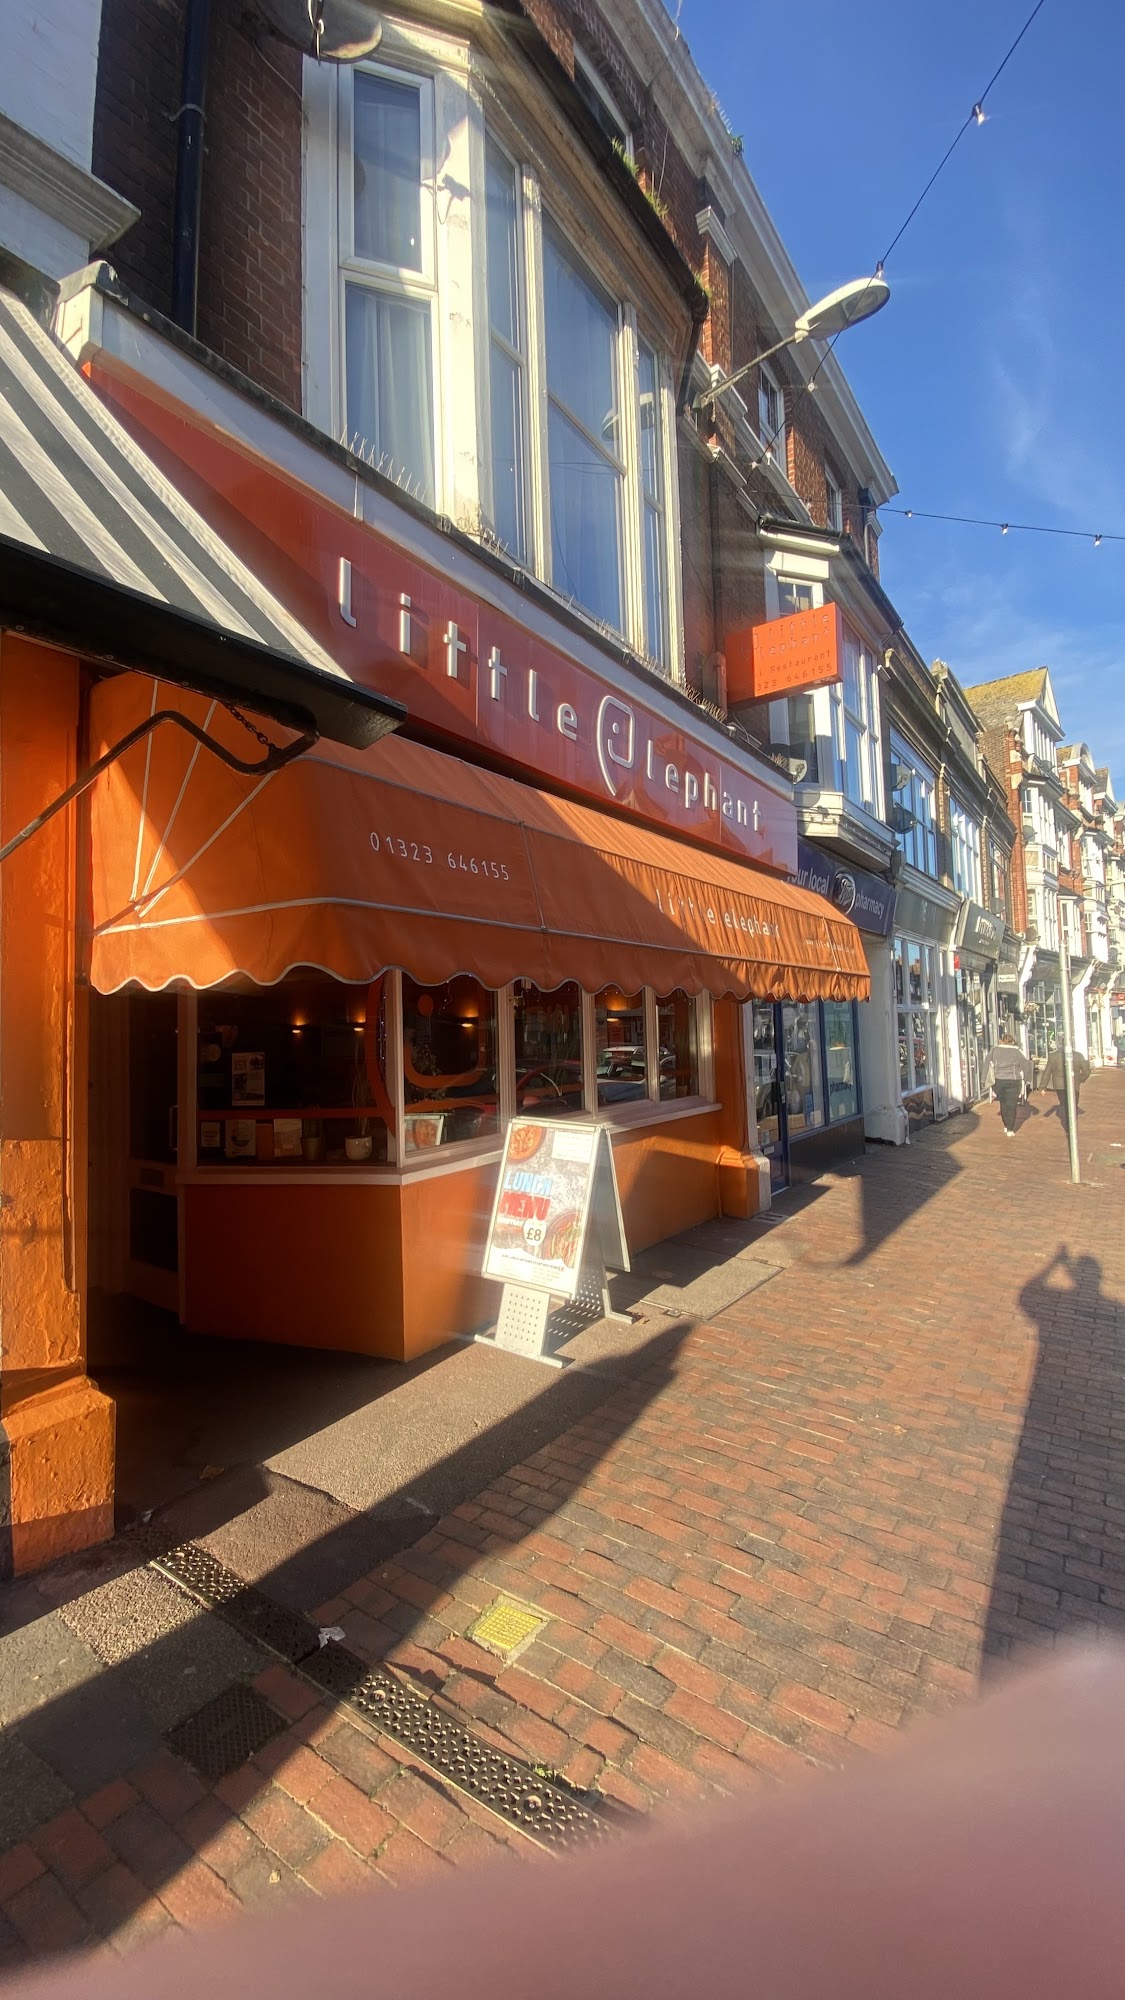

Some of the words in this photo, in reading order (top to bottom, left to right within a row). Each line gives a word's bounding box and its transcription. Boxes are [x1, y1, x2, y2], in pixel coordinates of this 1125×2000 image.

[769, 613, 830, 641] little
[339, 557, 578, 741] little
[769, 649, 831, 674] Restaurant
[786, 663, 832, 683] 646155
[370, 831, 433, 864] 01323
[447, 852, 510, 881] 646155
[808, 867, 830, 894] local
[854, 890, 885, 919] pharmacy
[723, 908, 781, 938] elephat
[503, 1169, 554, 1197] LUNCH
[498, 1190, 551, 1221] MENU
[526, 1227, 542, 1242] £8
